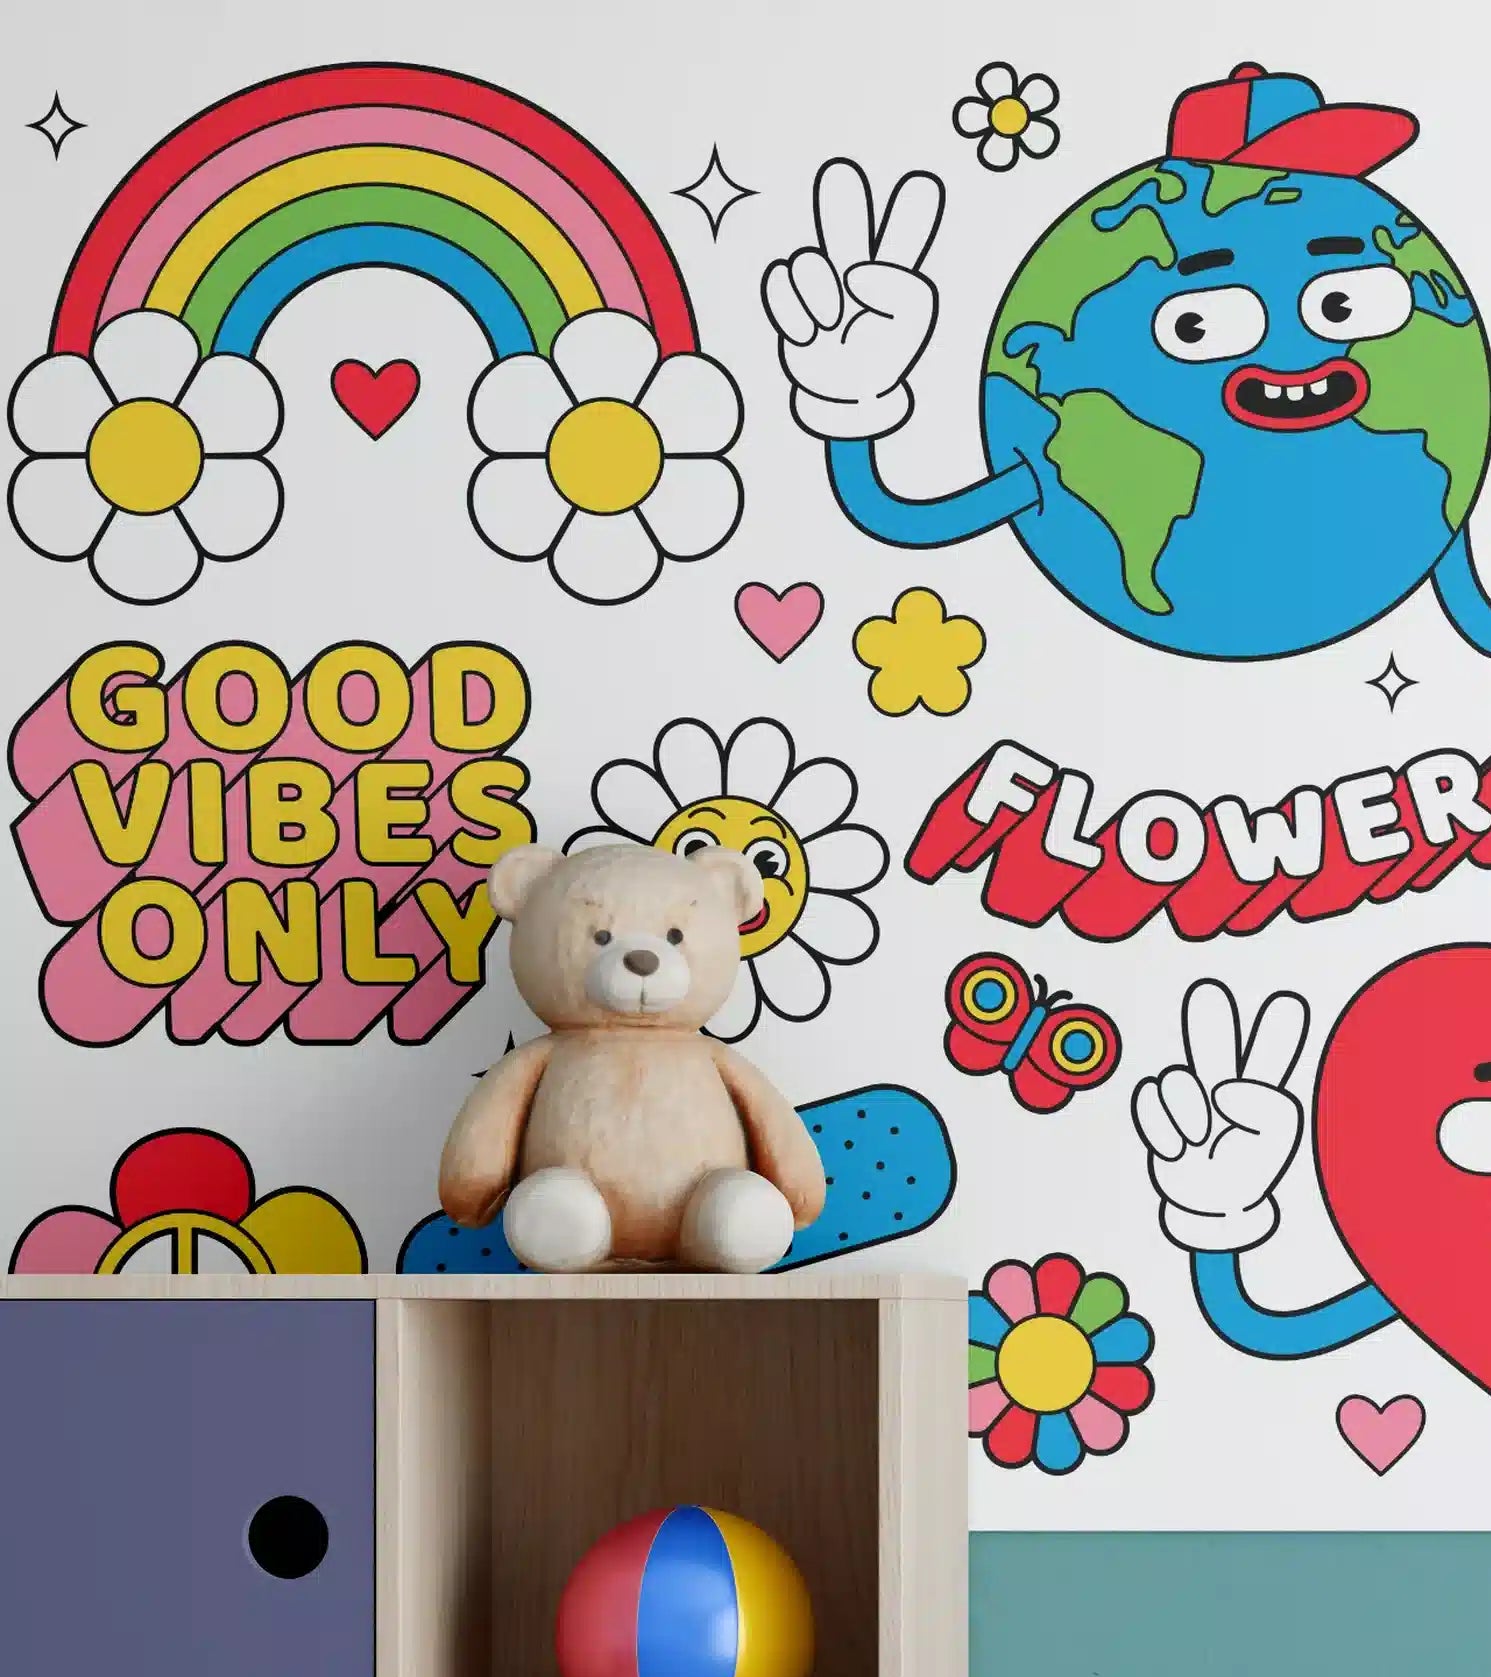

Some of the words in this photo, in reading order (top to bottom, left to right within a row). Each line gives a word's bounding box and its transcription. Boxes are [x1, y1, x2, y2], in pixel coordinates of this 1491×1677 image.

[66, 640, 532, 754] GOOD
[70, 757, 537, 867] VIBES
[963, 738, 1487, 886] FLOWER
[98, 876, 502, 988] ONLY
